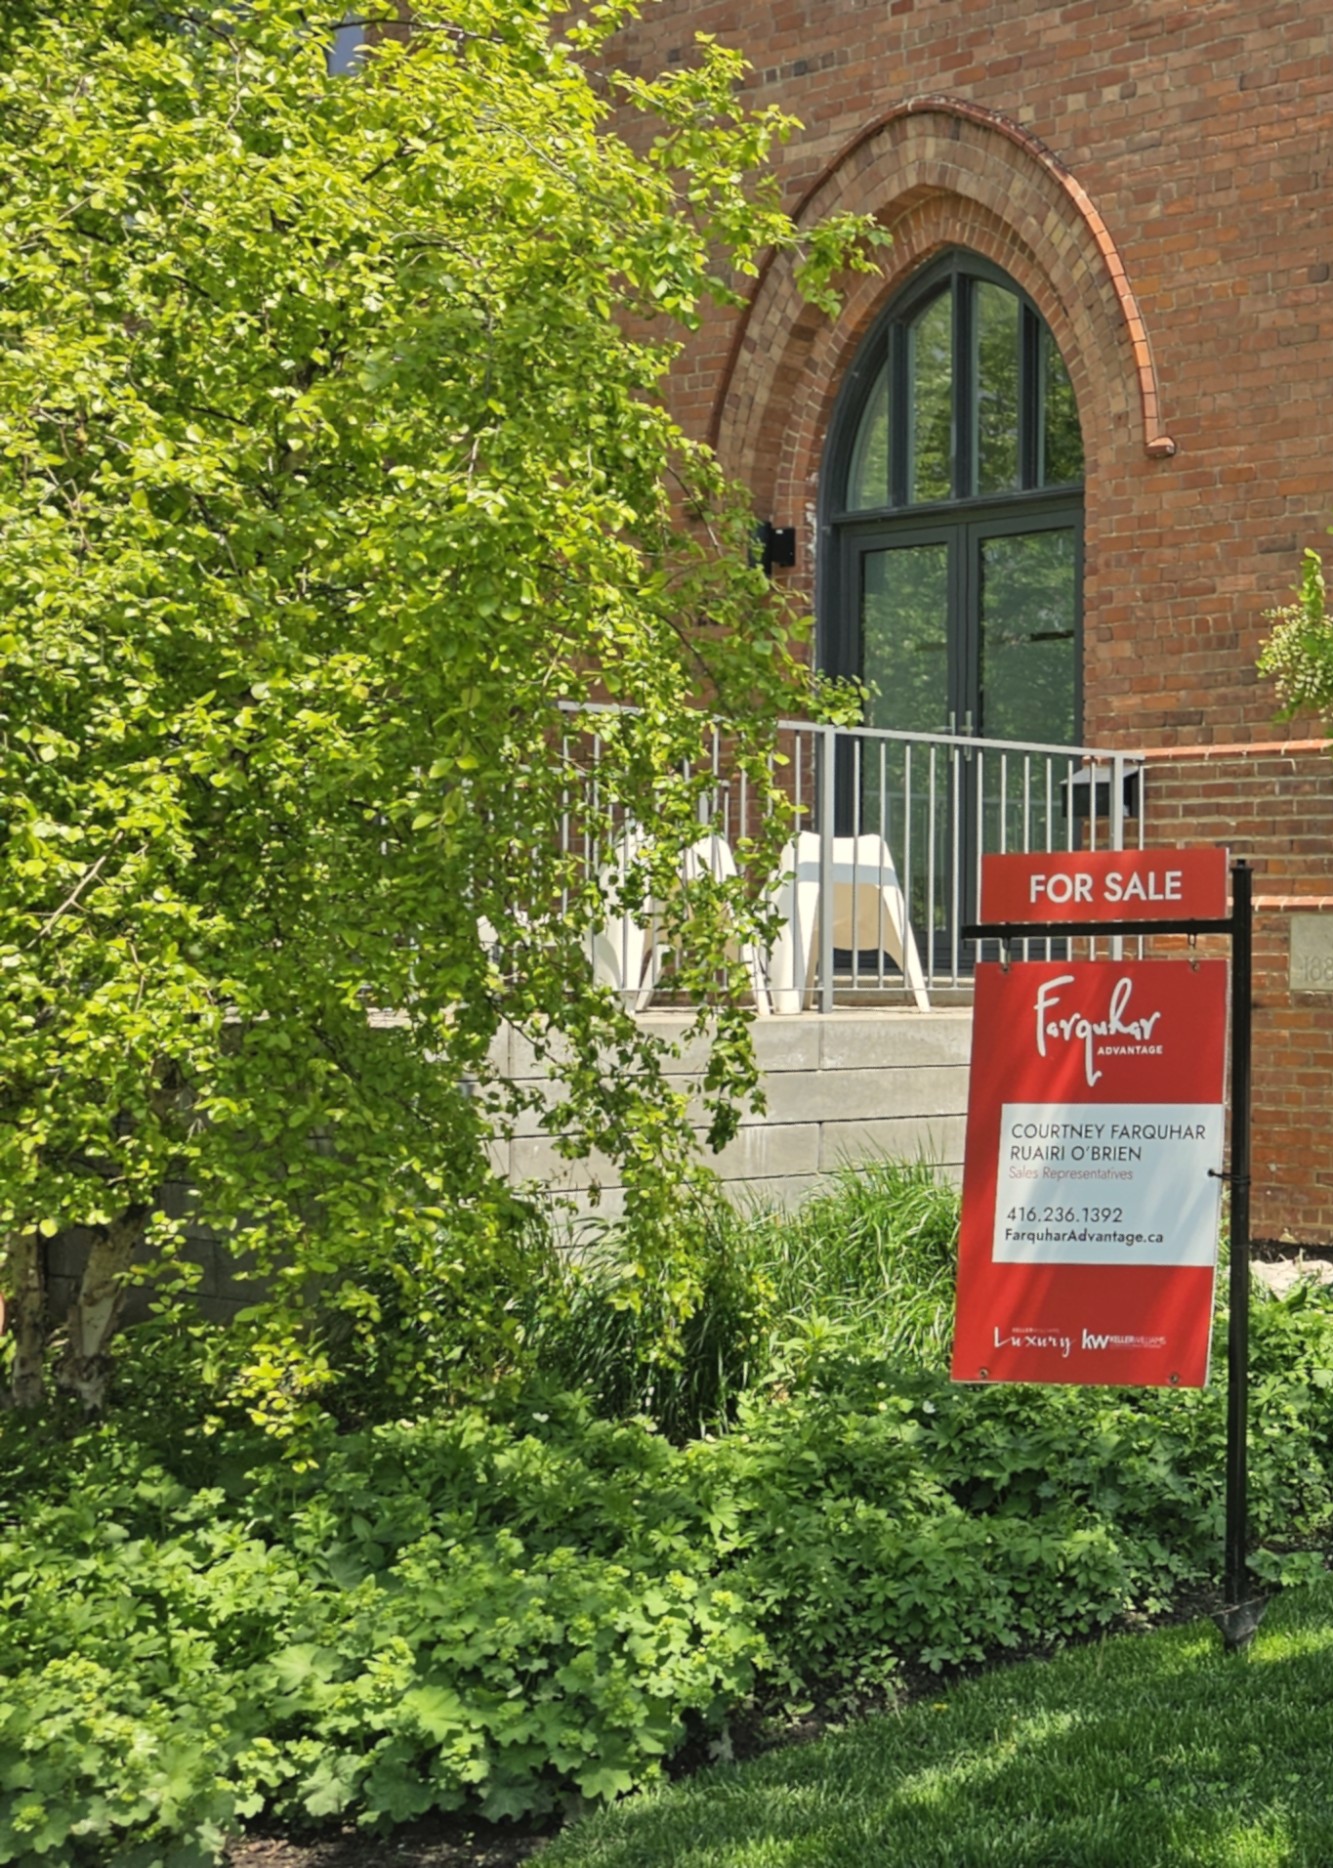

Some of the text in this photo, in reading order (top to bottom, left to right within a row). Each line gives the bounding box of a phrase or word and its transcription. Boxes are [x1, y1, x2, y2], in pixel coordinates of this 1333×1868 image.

[1029, 871, 1182, 903] FOR SALE
[1033, 975, 1161, 1087] Farquhar
[1097, 1045, 1164, 1055] ADVANTAGE
[1011, 1123, 1206, 1140] COURTNEY FARQUHAR
[1009, 1146, 1142, 1161] RUAIRI O'BRIEN
[1008, 1166, 1133, 1181] Sales Representatives
[1007, 1207, 1123, 1223] 416.236.1392
[1005, 1228, 1164, 1246] FarquharAdvantage.ca
[994, 1326, 1071, 1358] Luxury
